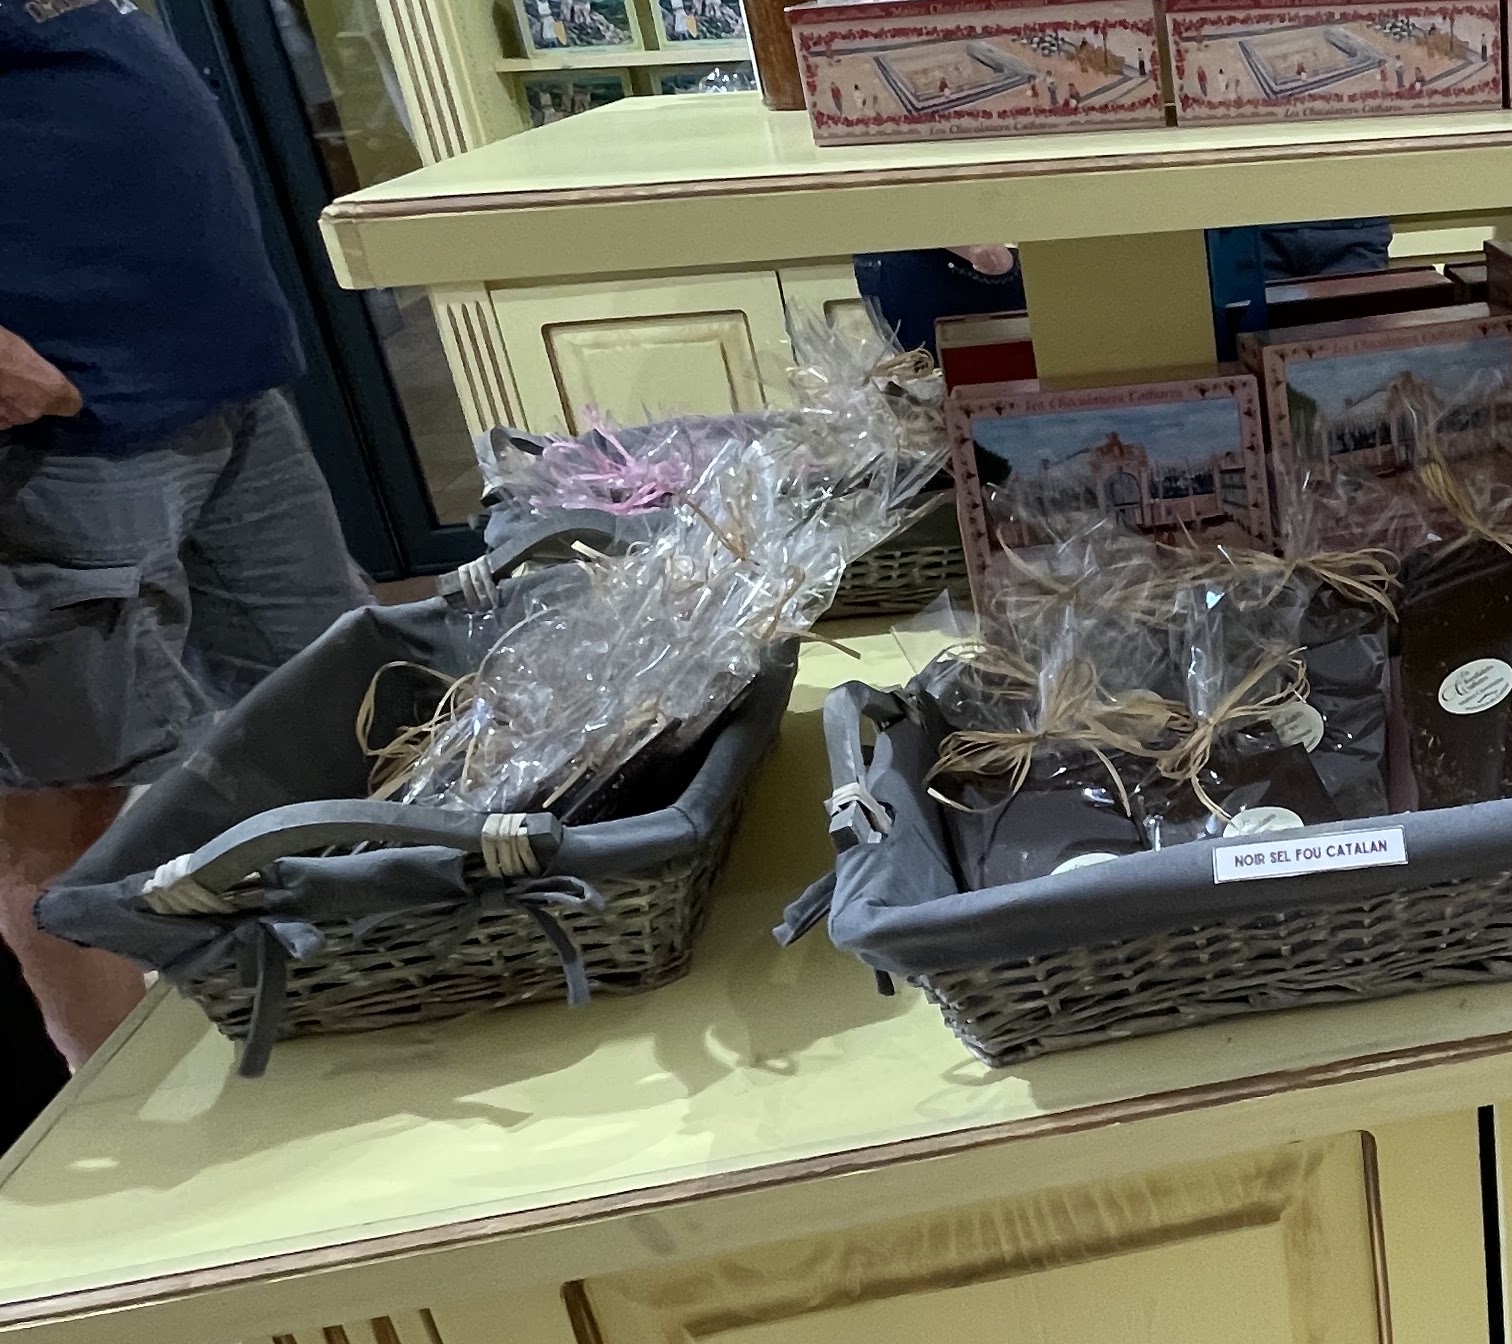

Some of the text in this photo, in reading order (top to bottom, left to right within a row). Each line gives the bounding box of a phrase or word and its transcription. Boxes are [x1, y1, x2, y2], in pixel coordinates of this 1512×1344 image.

[1235, 839, 1388, 868] NOIR SEL FOU CATALAN
